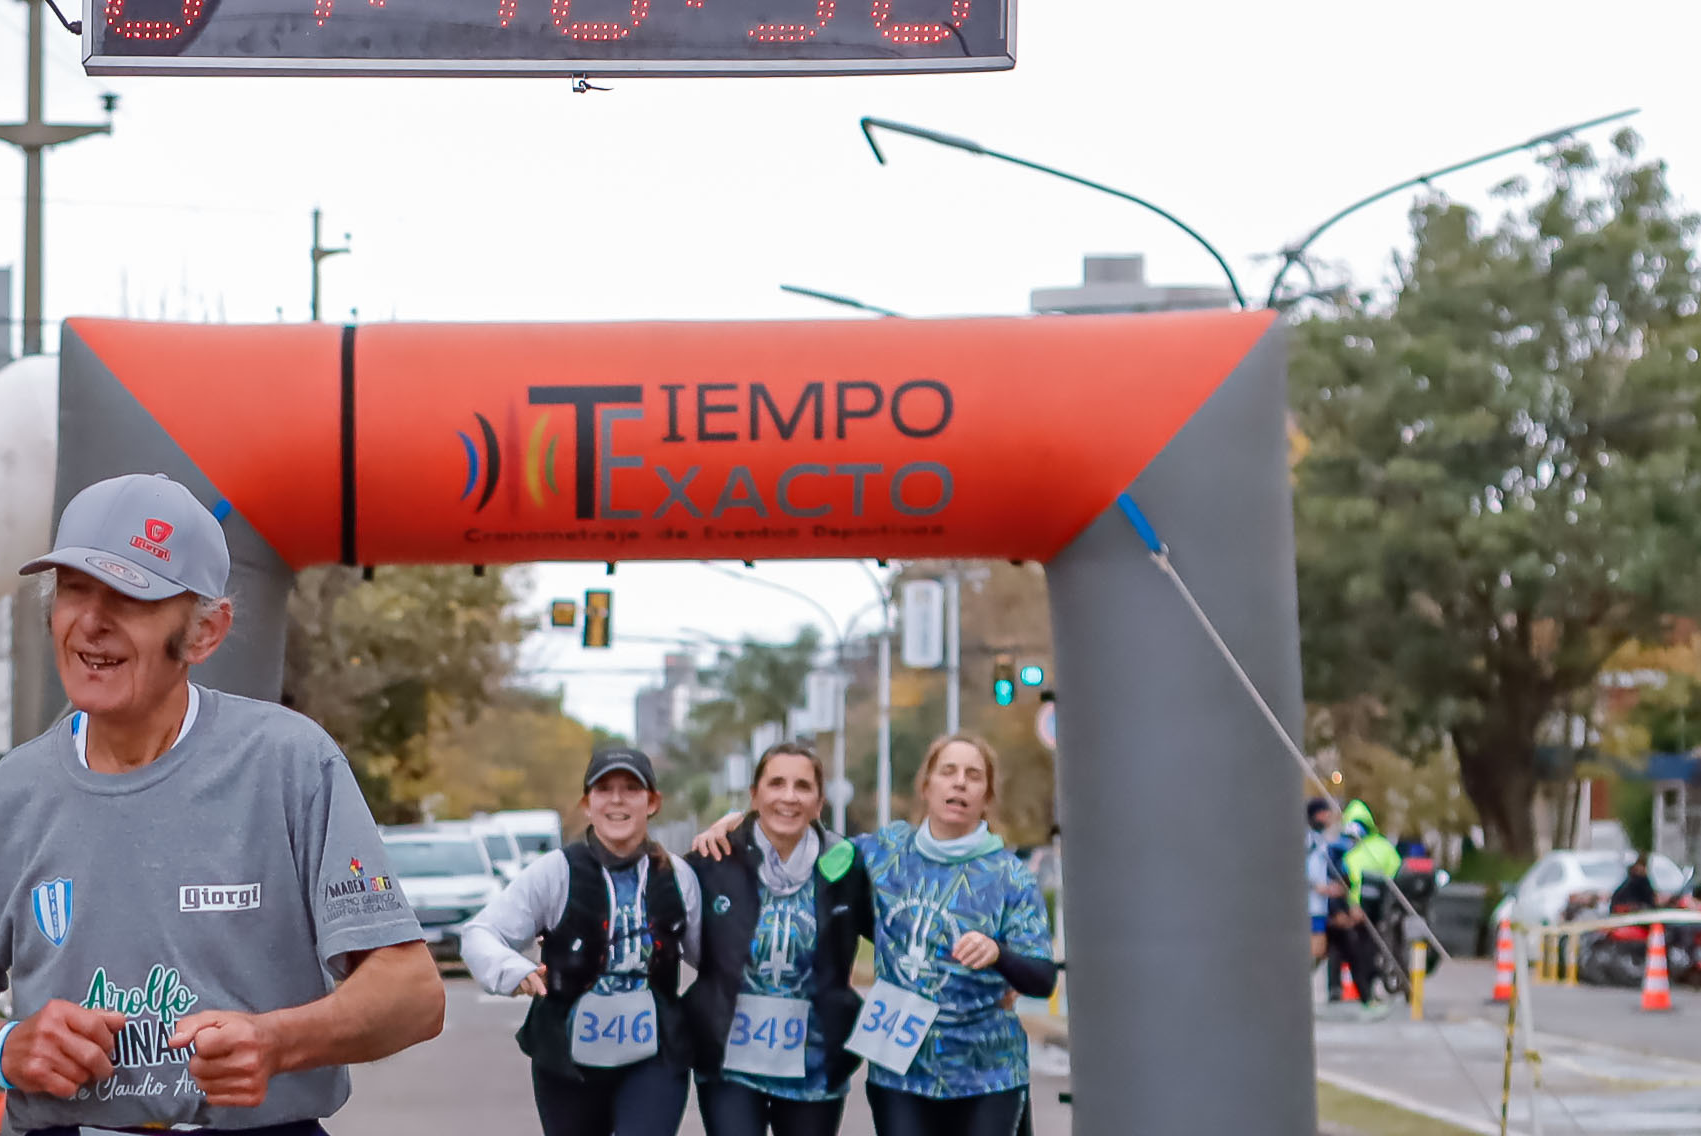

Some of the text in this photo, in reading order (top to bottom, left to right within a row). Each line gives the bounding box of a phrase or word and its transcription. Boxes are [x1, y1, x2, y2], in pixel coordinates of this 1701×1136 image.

[600, 408, 954, 520] EXACTO
[182, 885, 259, 910] giorgi
[80, 964, 198, 1025] Arolfo
[579, 1010, 653, 1044] 346
[730, 1012, 805, 1050] 349
[862, 1000, 926, 1048] 345
[96, 1071, 168, 1101] Claudio
